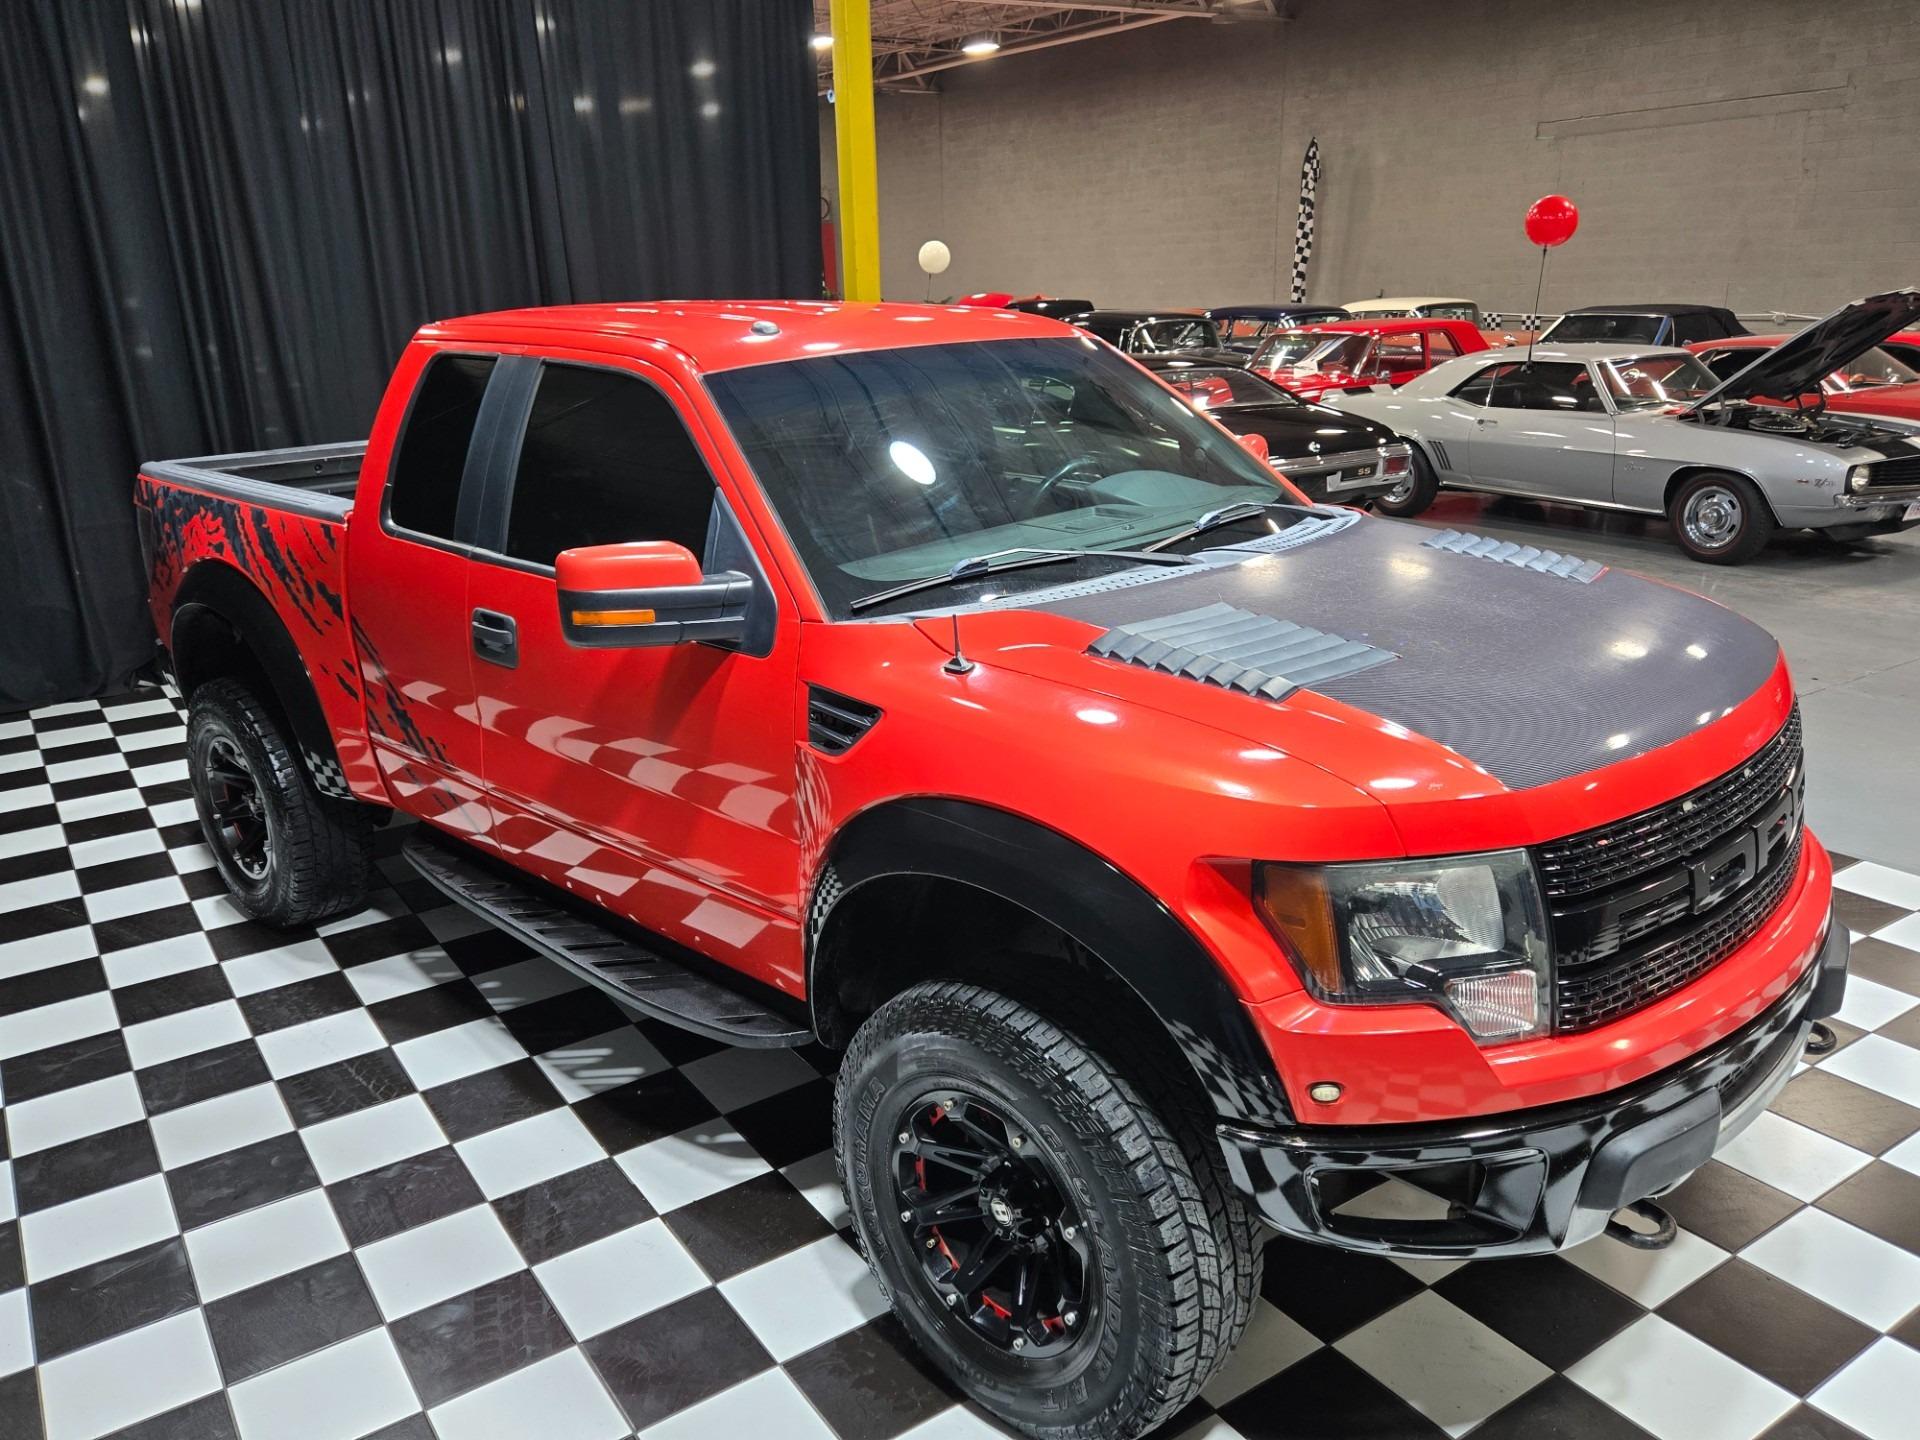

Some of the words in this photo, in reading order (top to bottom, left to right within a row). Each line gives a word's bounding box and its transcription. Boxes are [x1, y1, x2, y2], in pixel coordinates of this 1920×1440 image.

[1357, 467, 1371, 476] SS
[1553, 748, 1805, 966] FORD
[856, 1077, 888, 1262] YOKOHAMA
[1040, 1123, 1124, 1381] GEOLANDAR
